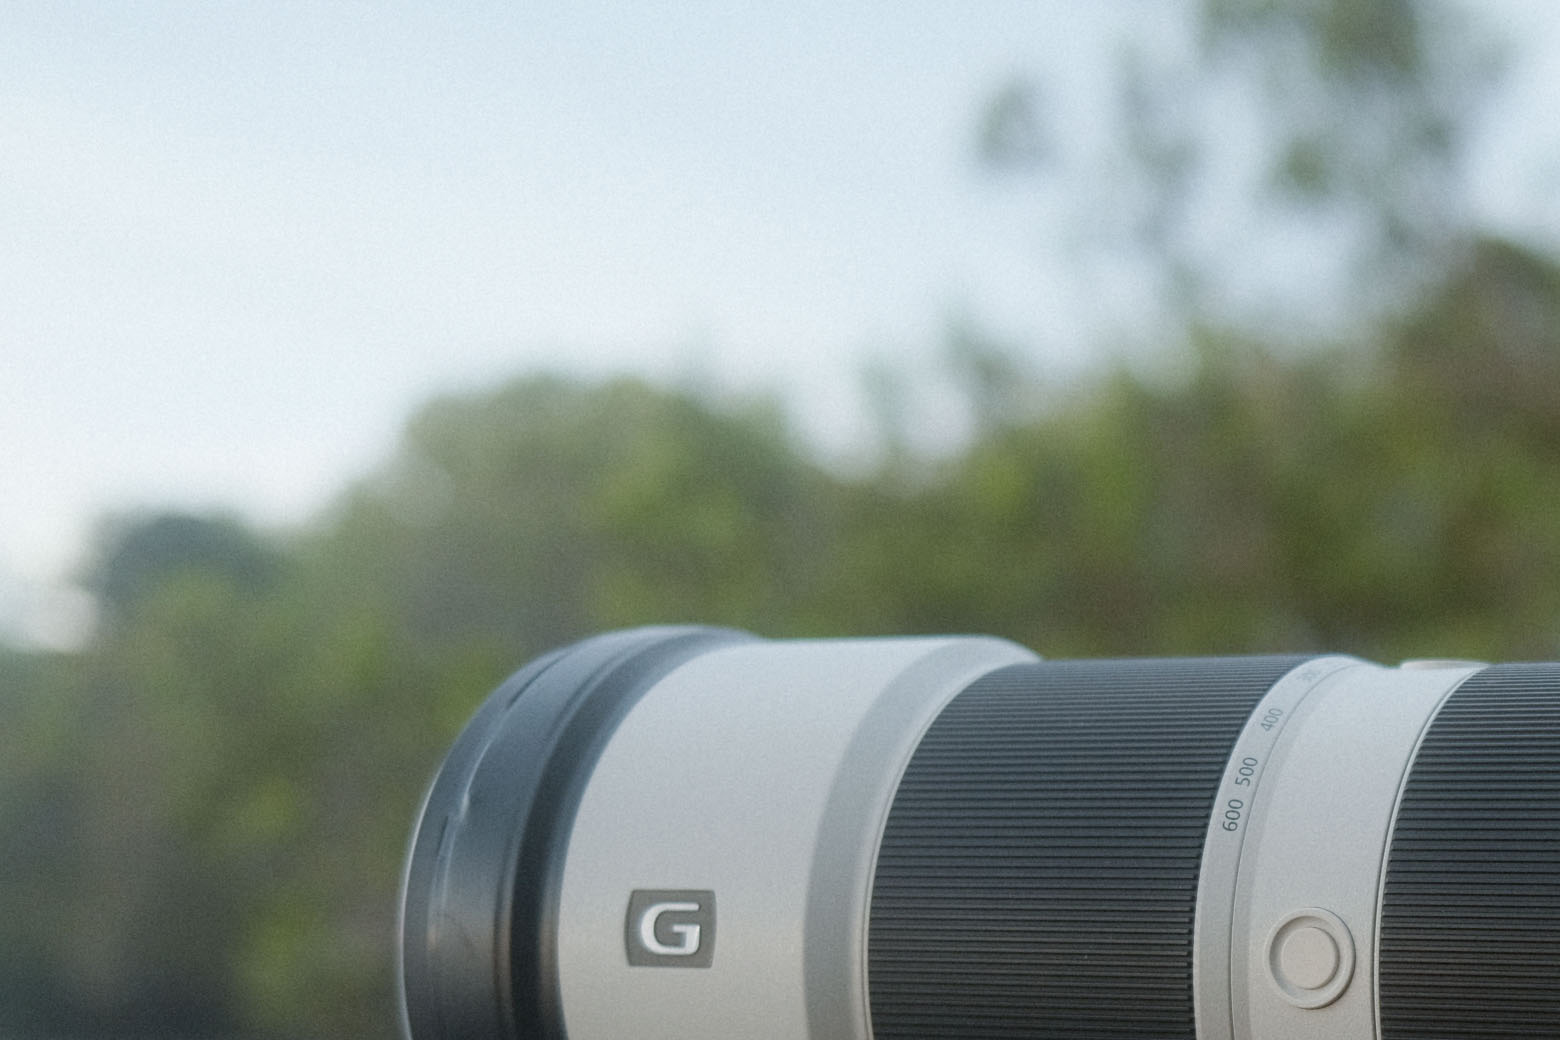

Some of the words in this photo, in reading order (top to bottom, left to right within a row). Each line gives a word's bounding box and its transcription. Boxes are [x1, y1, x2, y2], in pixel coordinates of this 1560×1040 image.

[1222, 798, 1244, 832] 600
[1234, 757, 1258, 787] 500
[1260, 707, 1284, 733] 400
[639, 902, 701, 956] G
